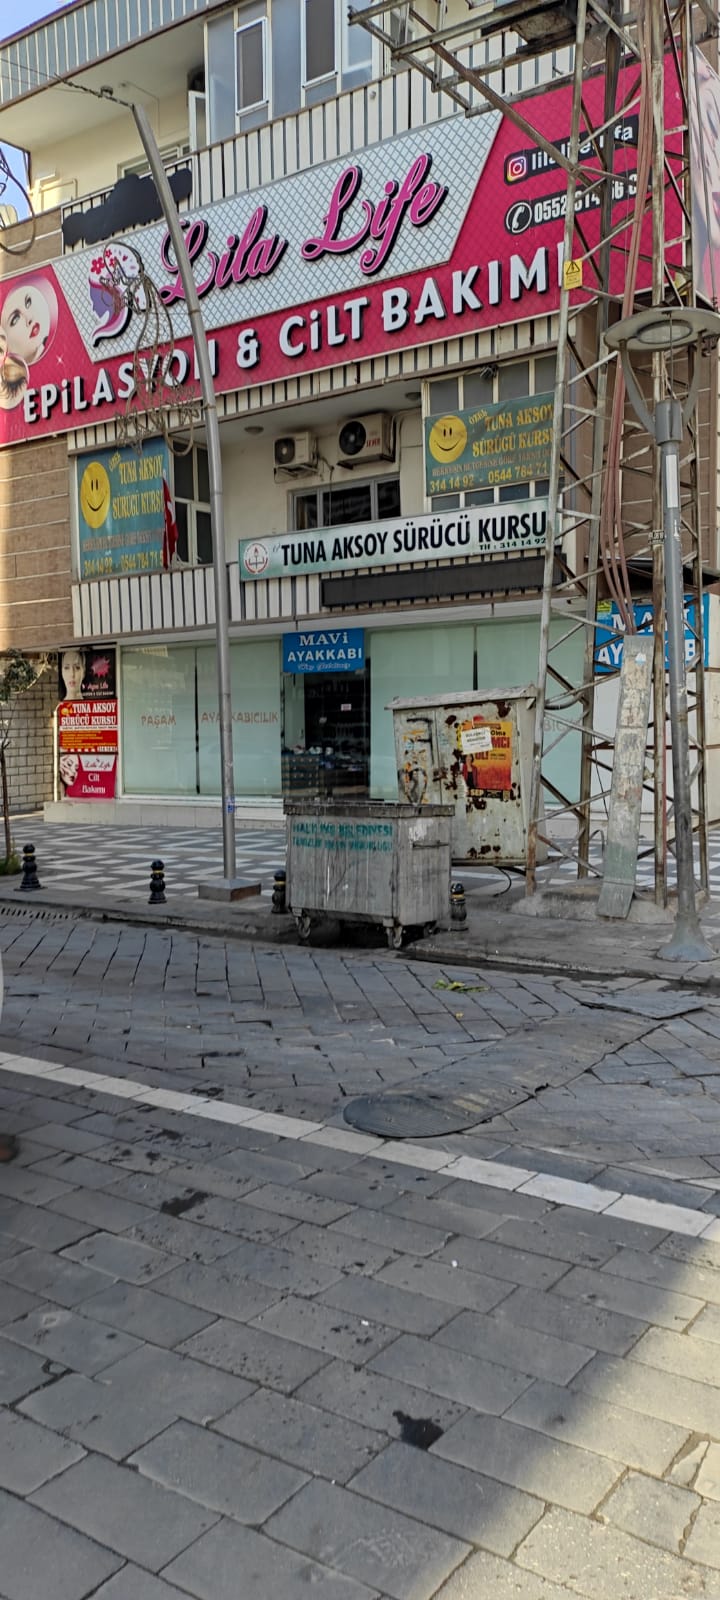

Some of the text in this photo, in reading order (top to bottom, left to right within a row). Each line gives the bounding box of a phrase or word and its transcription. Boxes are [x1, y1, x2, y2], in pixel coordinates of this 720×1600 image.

[534, 194, 569, 223] 0552
[159, 154, 447, 306] Lila Life
[236, 328, 259, 371] &
[484, 412, 513, 432] TUNA
[119, 454, 164, 485] TUNA AKSOY
[429, 481, 446, 493] 314
[449, 478, 460, 489] 14
[488, 467, 512, 484] 0544
[281, 511, 546, 567] TUNA AKSOY SÜRÜCÜ KURSU
[500, 541, 517, 549] 314
[534, 537, 546, 545] 92
[287, 648, 362, 662] AYAKKABI
[72, 702, 116, 713] TUNA AKSOY
[61, 713, 116, 726] SÜRÜCÜ KURSU
[88, 772, 100, 783] Cilt
